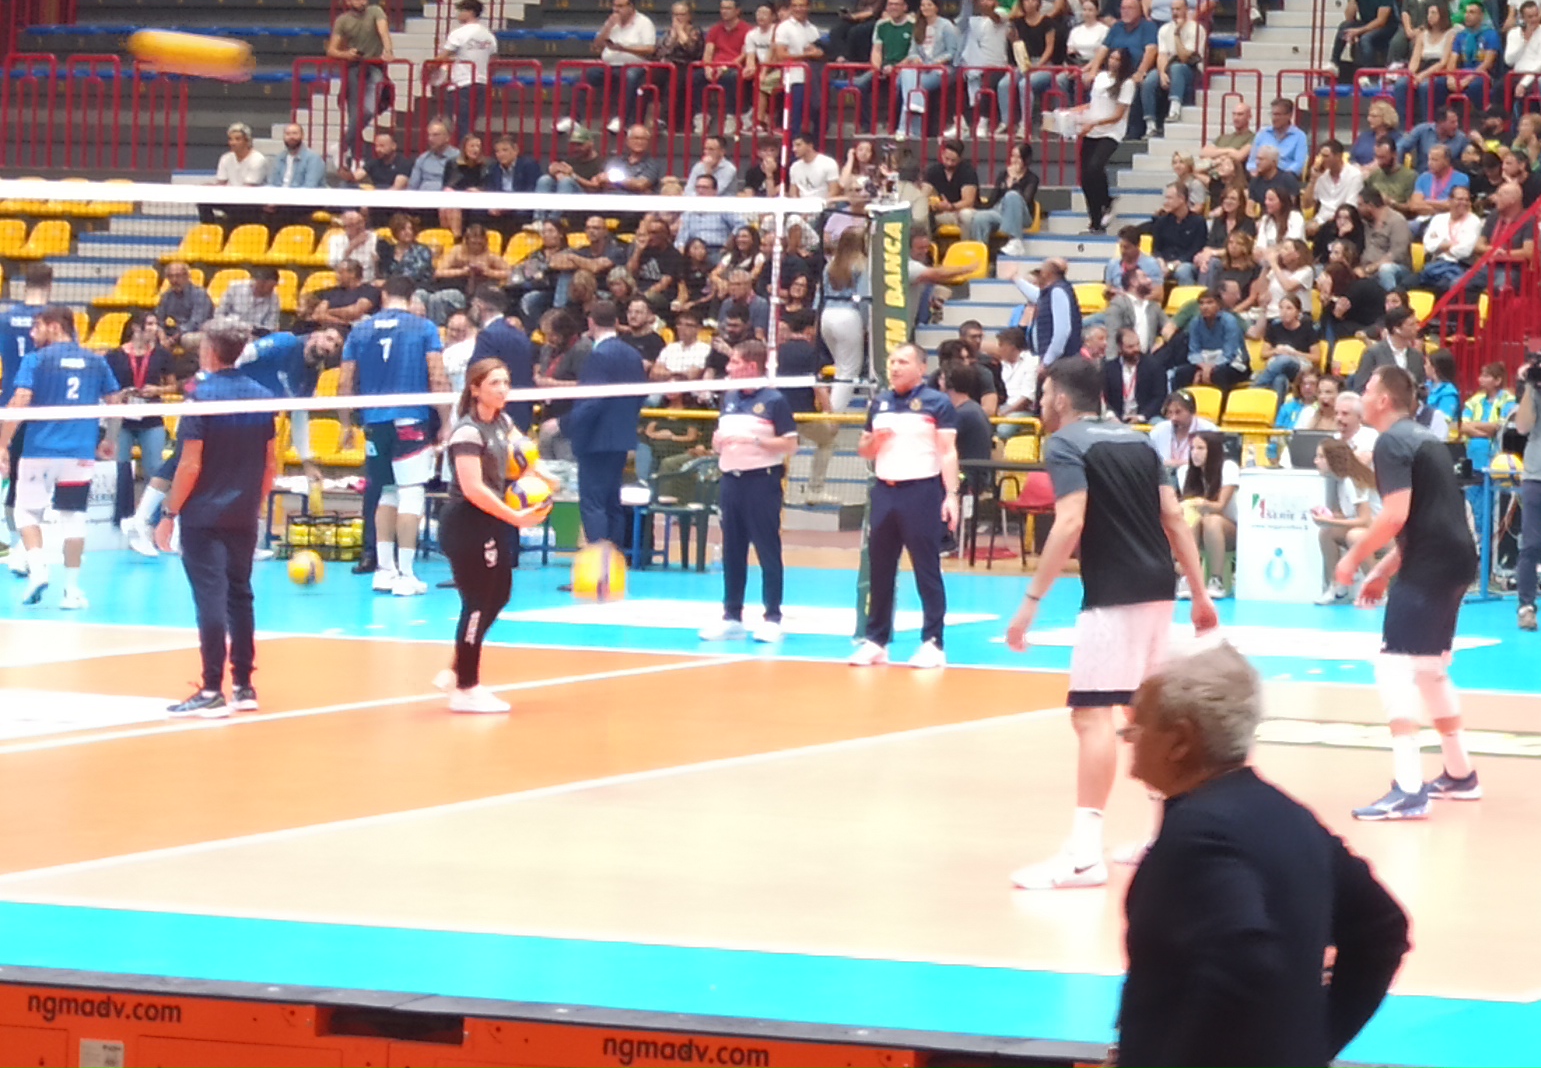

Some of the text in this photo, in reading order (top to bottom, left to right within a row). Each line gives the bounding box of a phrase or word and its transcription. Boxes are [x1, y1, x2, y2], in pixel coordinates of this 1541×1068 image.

[883, 221, 905, 308] BANCA
[66, 377, 80, 399] 2
[27, 994, 182, 1023] ngmadv.com
[602, 1037, 770, 1067] ngmadv.com
